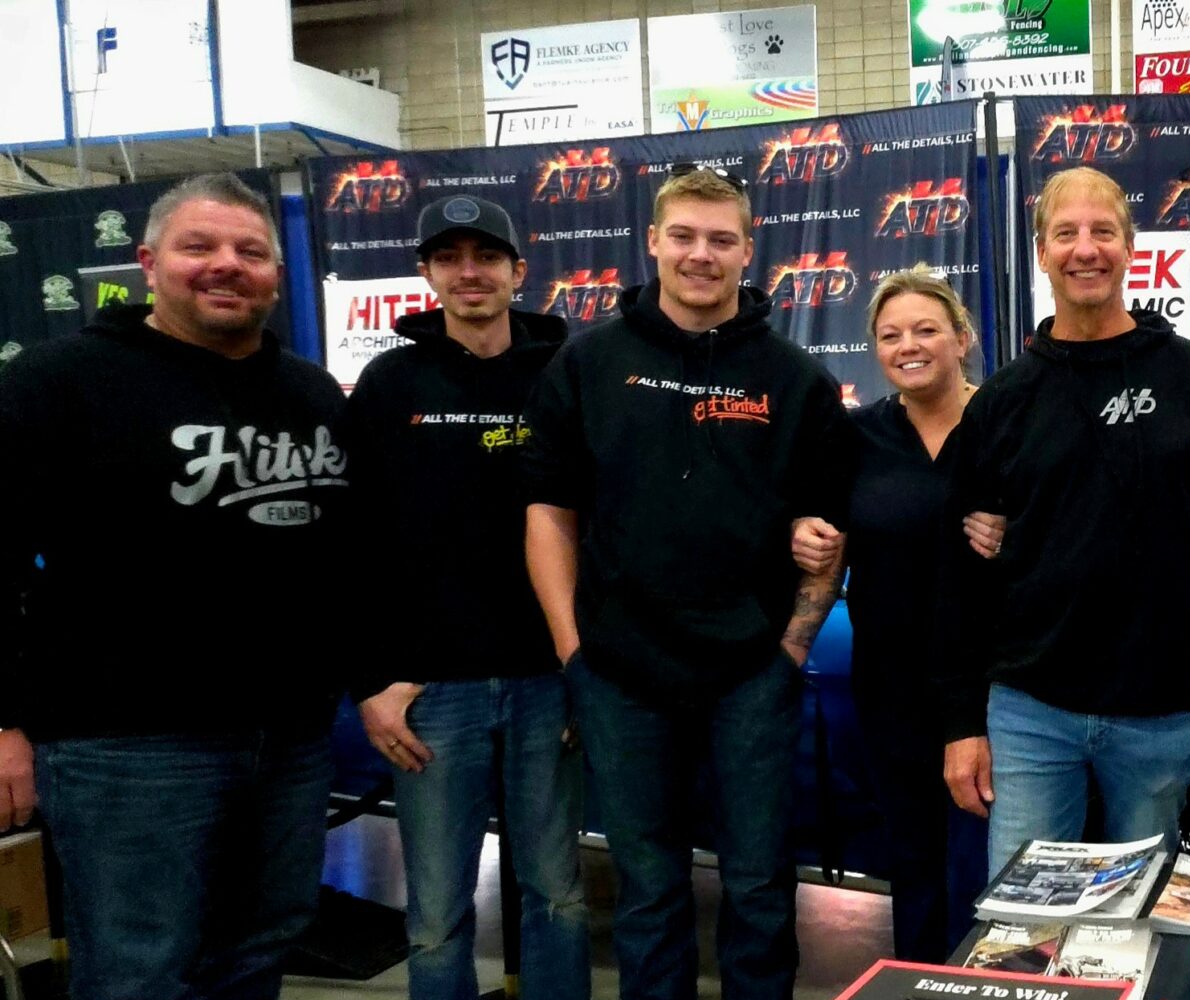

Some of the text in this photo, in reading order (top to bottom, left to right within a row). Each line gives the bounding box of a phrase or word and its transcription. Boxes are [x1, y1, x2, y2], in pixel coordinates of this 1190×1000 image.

[739, 12, 774, 35] Love
[1010, 19, 1043, 30] Fencing
[1141, 4, 1185, 36] Apex
[584, 40, 631, 56] AGENCY
[957, 69, 1087, 93] STONEWATER
[709, 105, 774, 120] Graphics
[607, 119, 634, 130] EASA
[1160, 126, 1180, 136] ALL
[872, 133, 973, 153] ALL THE DETAILS, LLC
[1032, 121, 1138, 162] ATD
[726, 156, 743, 166] LLC
[757, 142, 851, 184] ATD
[426, 178, 441, 187] ALL
[443, 177, 460, 187] THE
[500, 174, 517, 184] LLC
[532, 162, 622, 201] ATD
[1125, 193, 1144, 203] LLC
[763, 207, 860, 225] ALL THE DETAILS, LLC
[875, 195, 970, 238] ATD
[538, 232, 555, 241] ALL
[556, 231, 573, 240] THE
[614, 227, 631, 236] LLC
[961, 264, 980, 274] LLC
[770, 266, 858, 309] ATD
[808, 343, 868, 354] DETAILS, LLC
[637, 376, 746, 398] ALL THE LLC
[722, 393, 770, 415] tinted
[421, 414, 468, 423] ALL THE
[267, 506, 307, 522] FILMS
[914, 978, 978, 996] Enter
[981, 985, 1009, 998] To
